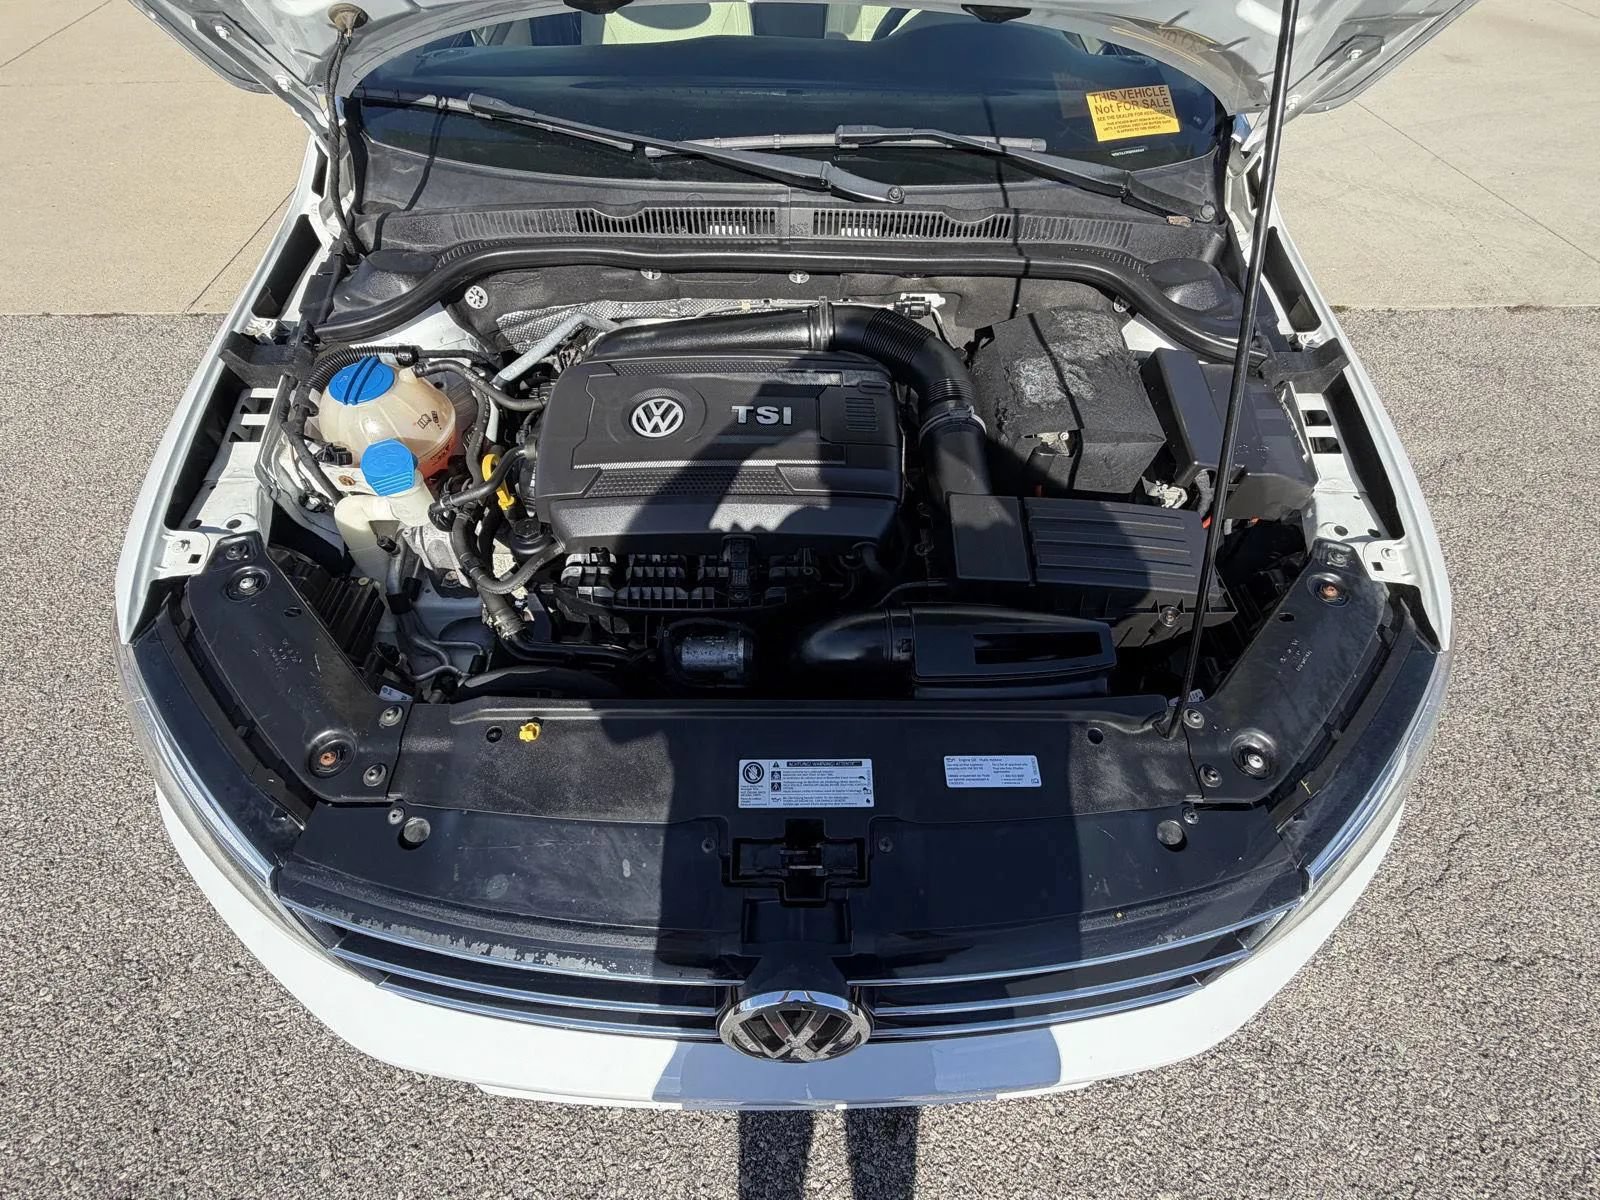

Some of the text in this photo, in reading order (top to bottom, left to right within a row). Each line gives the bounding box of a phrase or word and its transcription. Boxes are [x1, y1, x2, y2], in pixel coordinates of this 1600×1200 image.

[1093, 87, 1167, 103] THIS VEHICLE
[1095, 97, 1171, 115] Not FOR SALE
[731, 405, 792, 425] TSI
